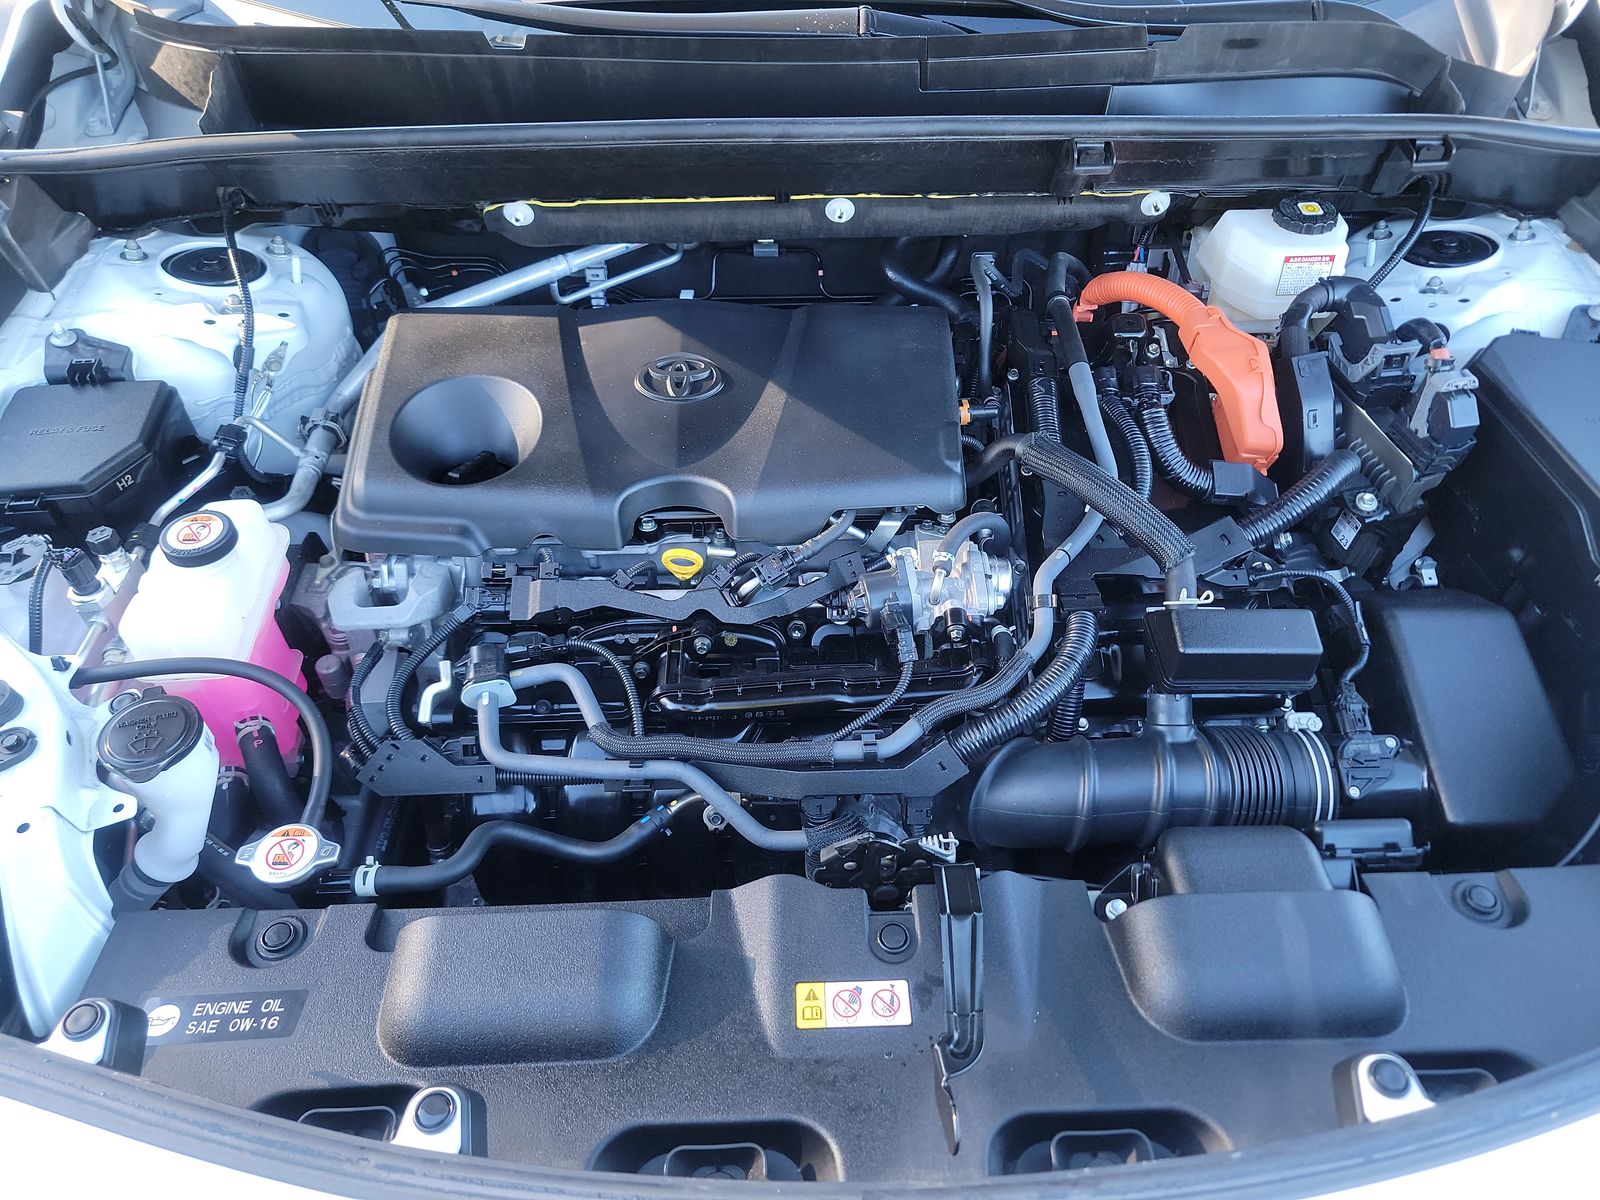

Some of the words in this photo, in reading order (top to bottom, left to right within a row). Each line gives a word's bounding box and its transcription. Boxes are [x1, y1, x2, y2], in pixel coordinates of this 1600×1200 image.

[30, 427, 66, 436] RELAY
[77, 425, 105, 433] FUSE
[116, 474, 135, 491] H2
[1340, 535, 1349, 547] 23
[192, 1000, 252, 1016] ENGINE
[261, 998, 285, 1013] OIL
[185, 1019, 220, 1035] SAE
[228, 1016, 280, 1032] 0W-16
